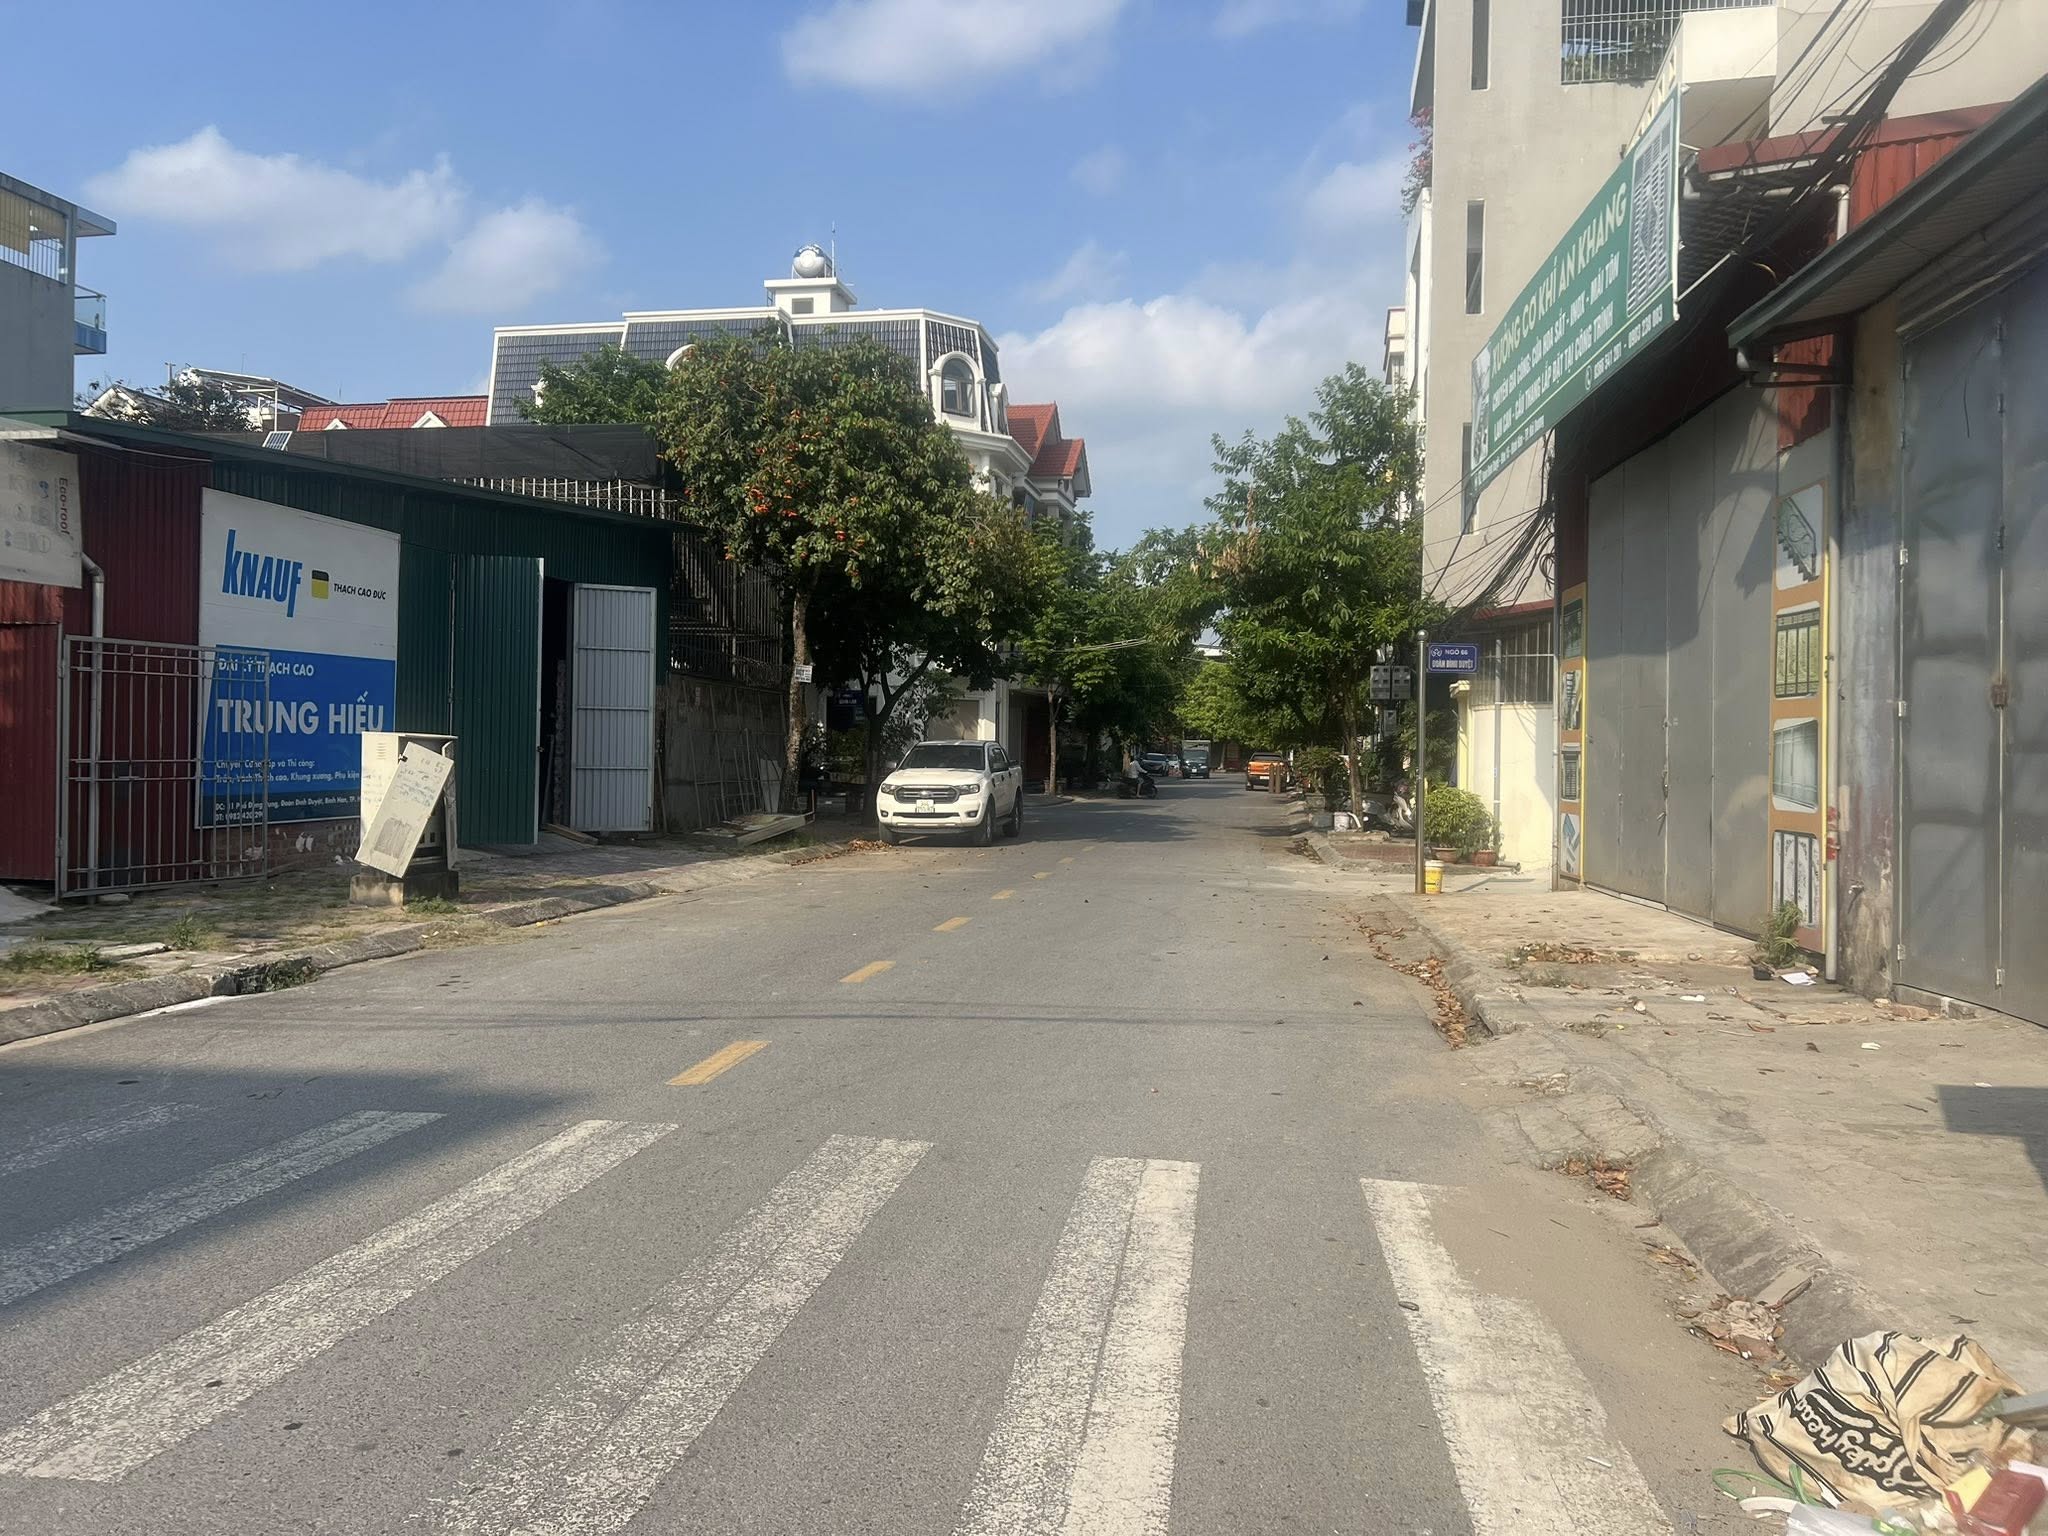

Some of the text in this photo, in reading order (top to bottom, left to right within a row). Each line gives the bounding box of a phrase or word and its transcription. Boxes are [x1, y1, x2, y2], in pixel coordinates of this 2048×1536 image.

[1491, 181, 1627, 379] XƯỞNG CƠ KHÍ AN KHANG
[333, 583, 356, 595] THẠCH
[357, 587, 372, 598] CAO
[293, 664, 314, 677] CAO
[217, 690, 384, 735] TRUNG HIẾU
[287, 758, 297, 767] Thi
[275, 774, 289, 783] cao,
[290, 771, 311, 783] Khung
[334, 770, 346, 781] Phụ
[347, 769, 360, 780] kiện
